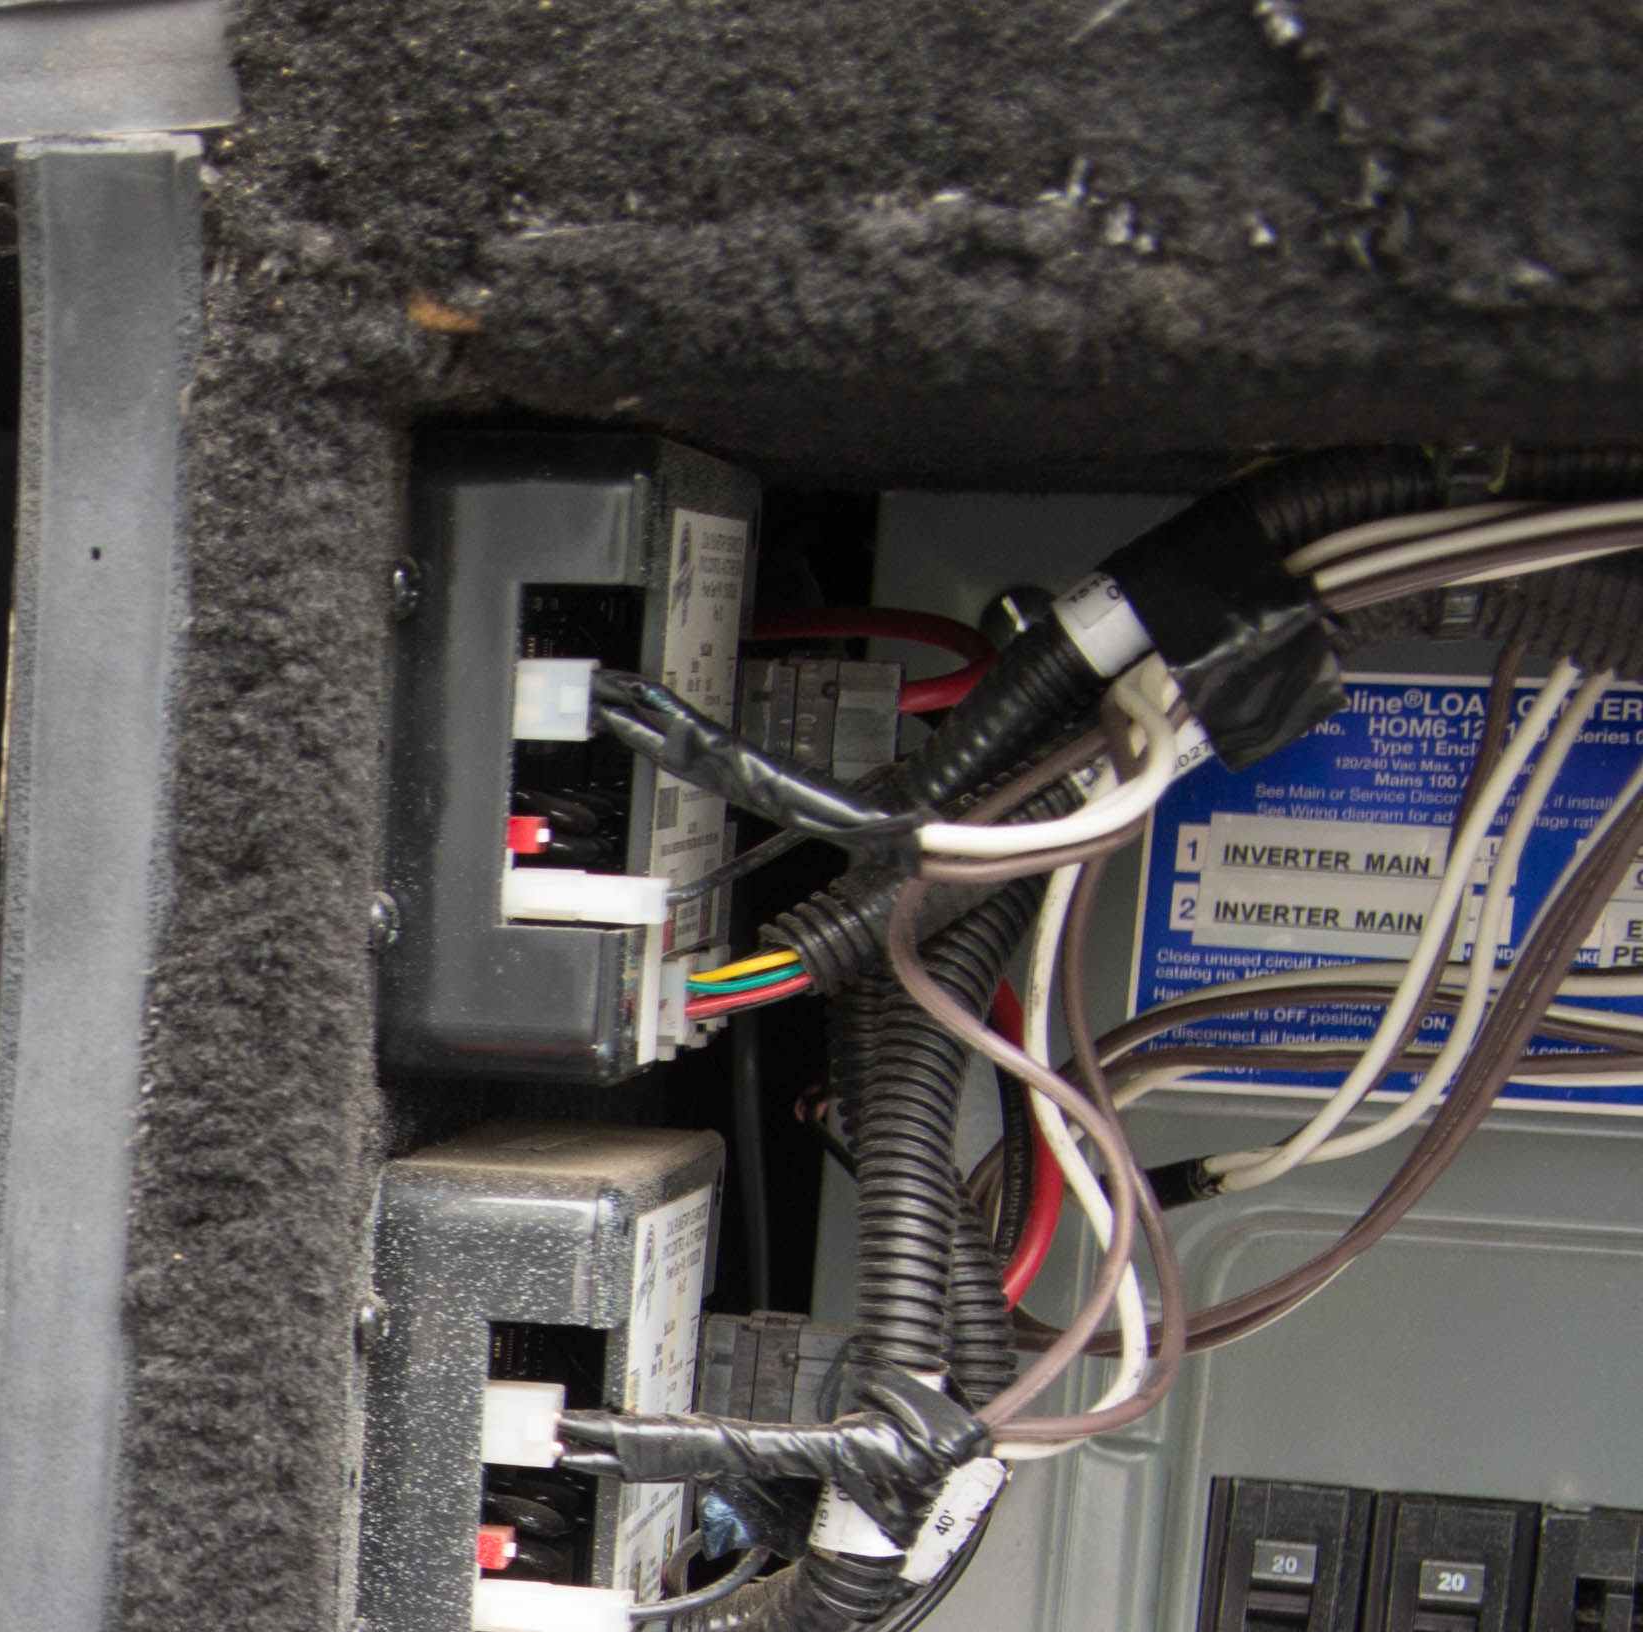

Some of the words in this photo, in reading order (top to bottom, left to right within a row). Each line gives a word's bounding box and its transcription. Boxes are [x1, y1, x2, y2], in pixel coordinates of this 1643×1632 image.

[1423, 692, 1485, 716] LOA
[1315, 721, 1346, 735] No.
[1372, 739, 1413, 755] Type
[1420, 742, 1428, 754] 1
[1335, 756, 1387, 770] 120/240
[1374, 772, 1423, 787] Mains
[1429, 776, 1456, 788] 100
[1255, 783, 1284, 798] See
[1289, 784, 1325, 799] Main
[1330, 788, 1345, 800] or
[1350, 787, 1405, 803] Service
[1409, 810, 1429, 822] for
[1187, 840, 1198, 862] 1
[1223, 843, 1351, 871] INVERTER
[1364, 853, 1431, 876] MAIN
[1179, 899, 1196, 920] 2
[1214, 900, 1340, 928] INVERTER
[1355, 911, 1424, 932] MAIN
[1156, 949, 1200, 965] Close
[1205, 953, 1261, 968] unused
[1265, 954, 1312, 969] circuit
[1154, 965, 1212, 984] catalog
[1273, 1008, 1308, 1023] OFF
[1171, 1027, 1255, 1043] disconnect
[1259, 1032, 1277, 1044] all
[1271, 1556, 1298, 1574] 20
[1436, 1572, 1466, 1592] 20
